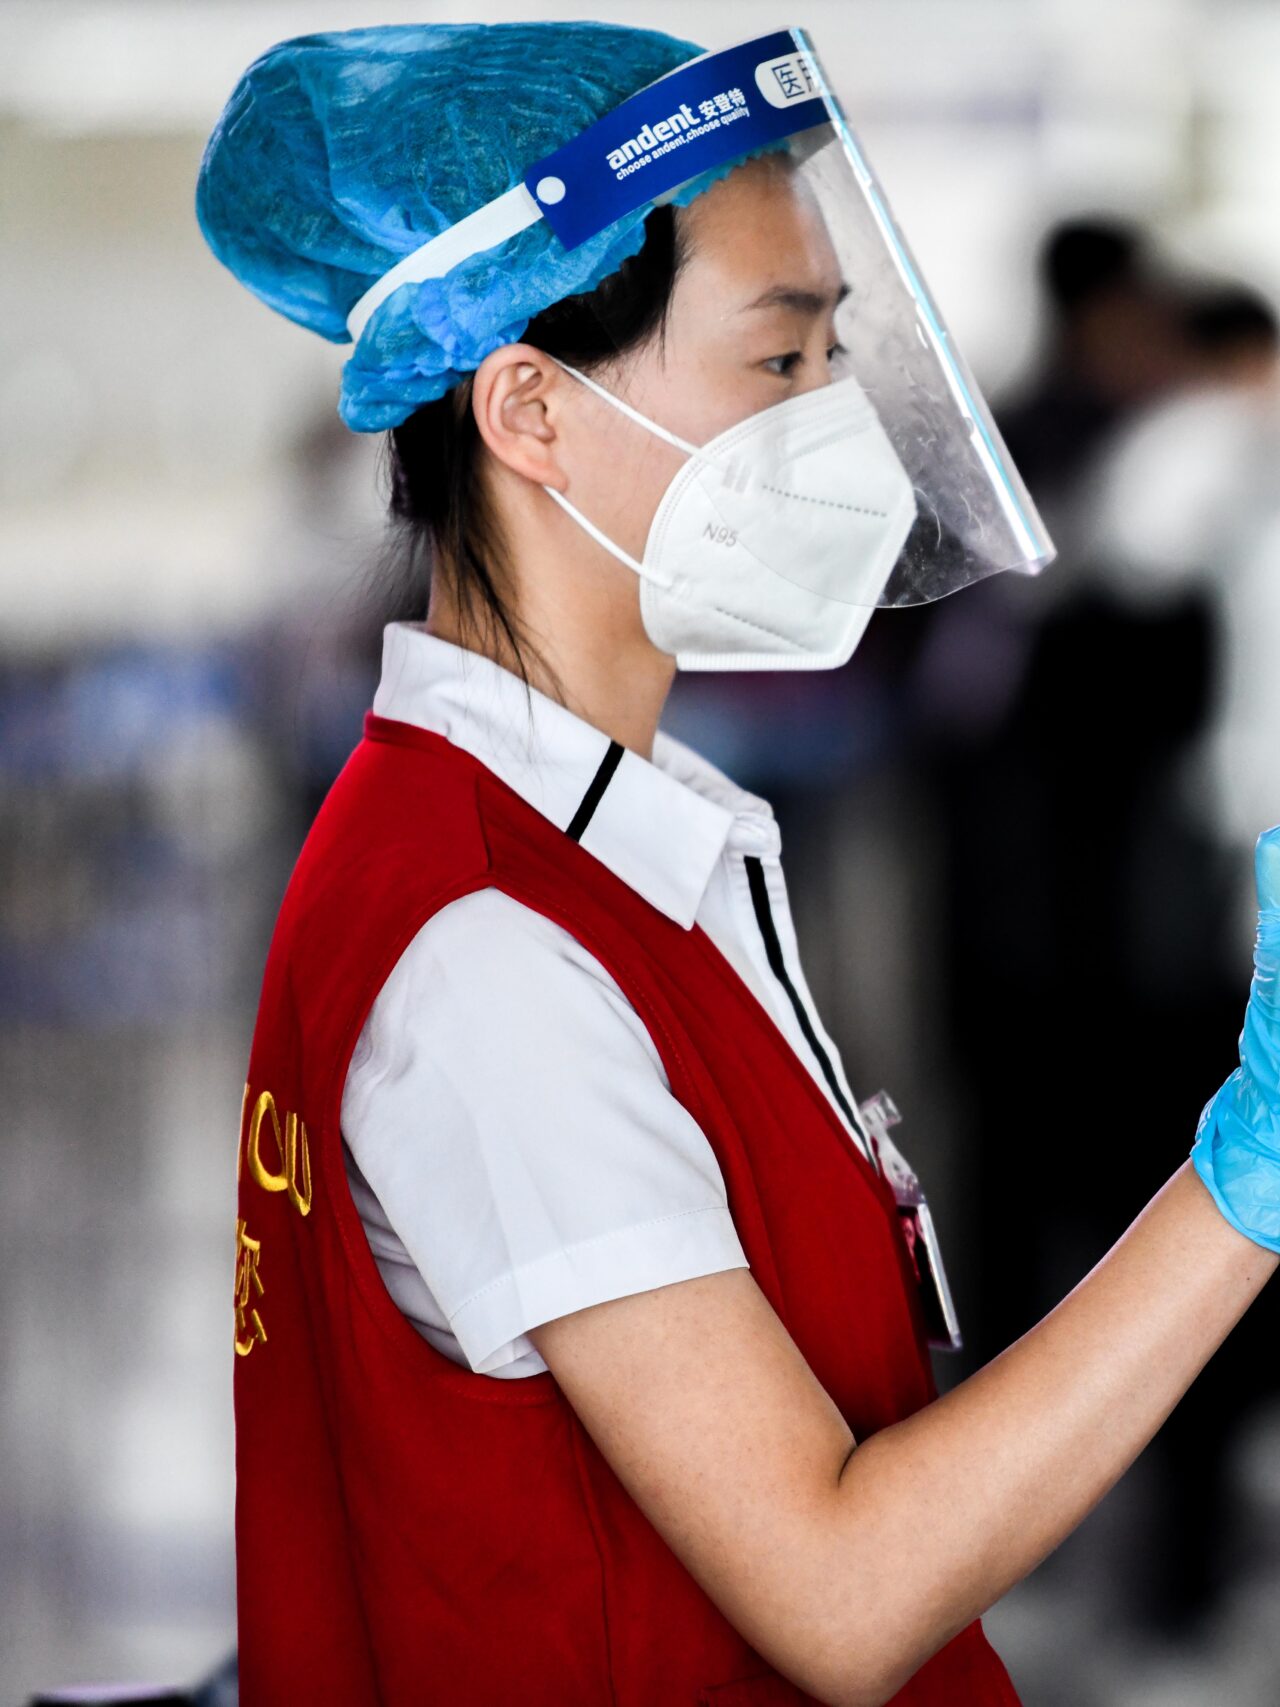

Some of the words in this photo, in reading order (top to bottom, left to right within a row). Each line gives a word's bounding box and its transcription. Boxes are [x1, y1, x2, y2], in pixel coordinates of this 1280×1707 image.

[605, 104, 701, 170] andent
[698, 88, 746, 121] 安登特
[616, 152, 652, 181] choose
[720, 105, 750, 126] quality
[703, 522, 740, 548] N95
